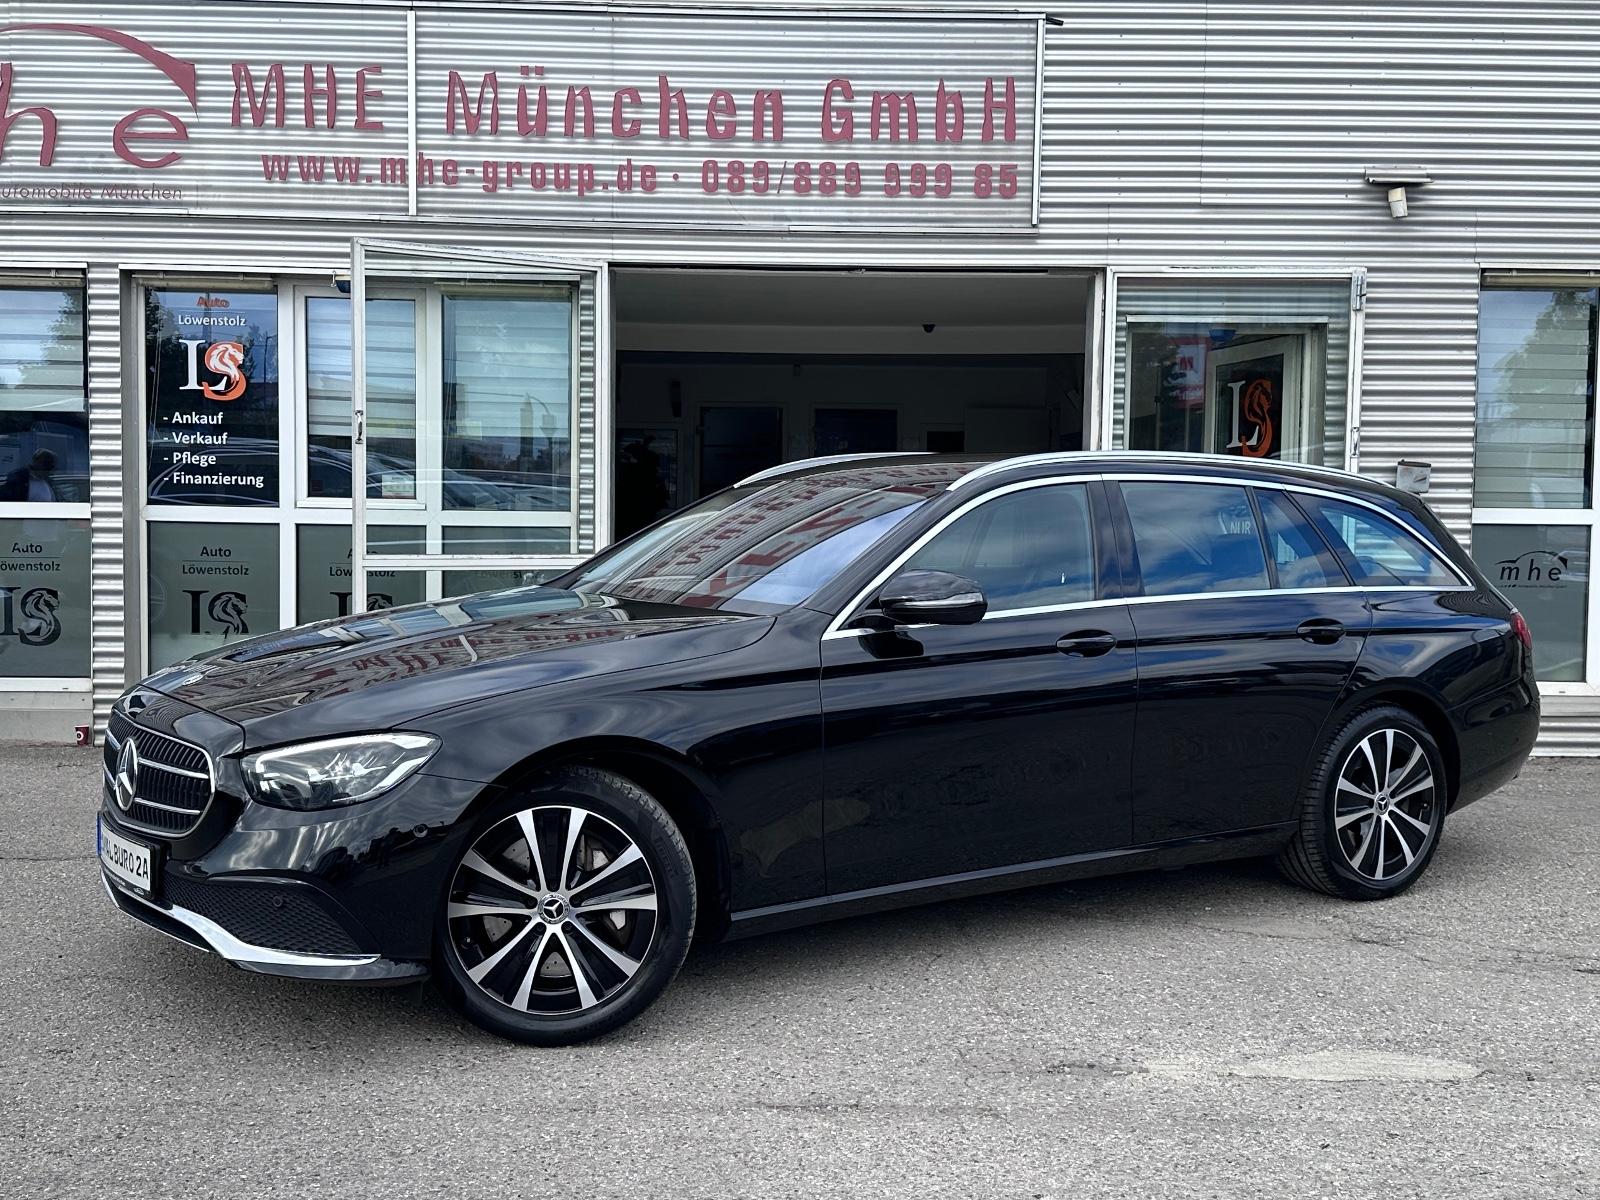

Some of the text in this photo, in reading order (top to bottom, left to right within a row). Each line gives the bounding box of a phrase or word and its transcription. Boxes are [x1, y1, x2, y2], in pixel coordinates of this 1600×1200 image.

[231, 63, 1017, 143] MHE München GmbH
[0, 62, 189, 169] he
[262, 152, 1018, 199] www.mhe-group.de 089/889 999 85
[1, 183, 93, 200] utomobile
[178, 314, 246, 326] Löwenstolz
[171, 411, 224, 425] Ankauf
[172, 431, 228, 445] Verkauf
[173, 451, 217, 467] Pflege
[173, 471, 264, 488] Finanzierung
[11, 542, 43, 554] Auto
[200, 546, 232, 557] Auto
[0, 560, 61, 572] öwenstolz
[182, 564, 249, 576] Löwenstolz
[135, 855, 150, 880] 2A
